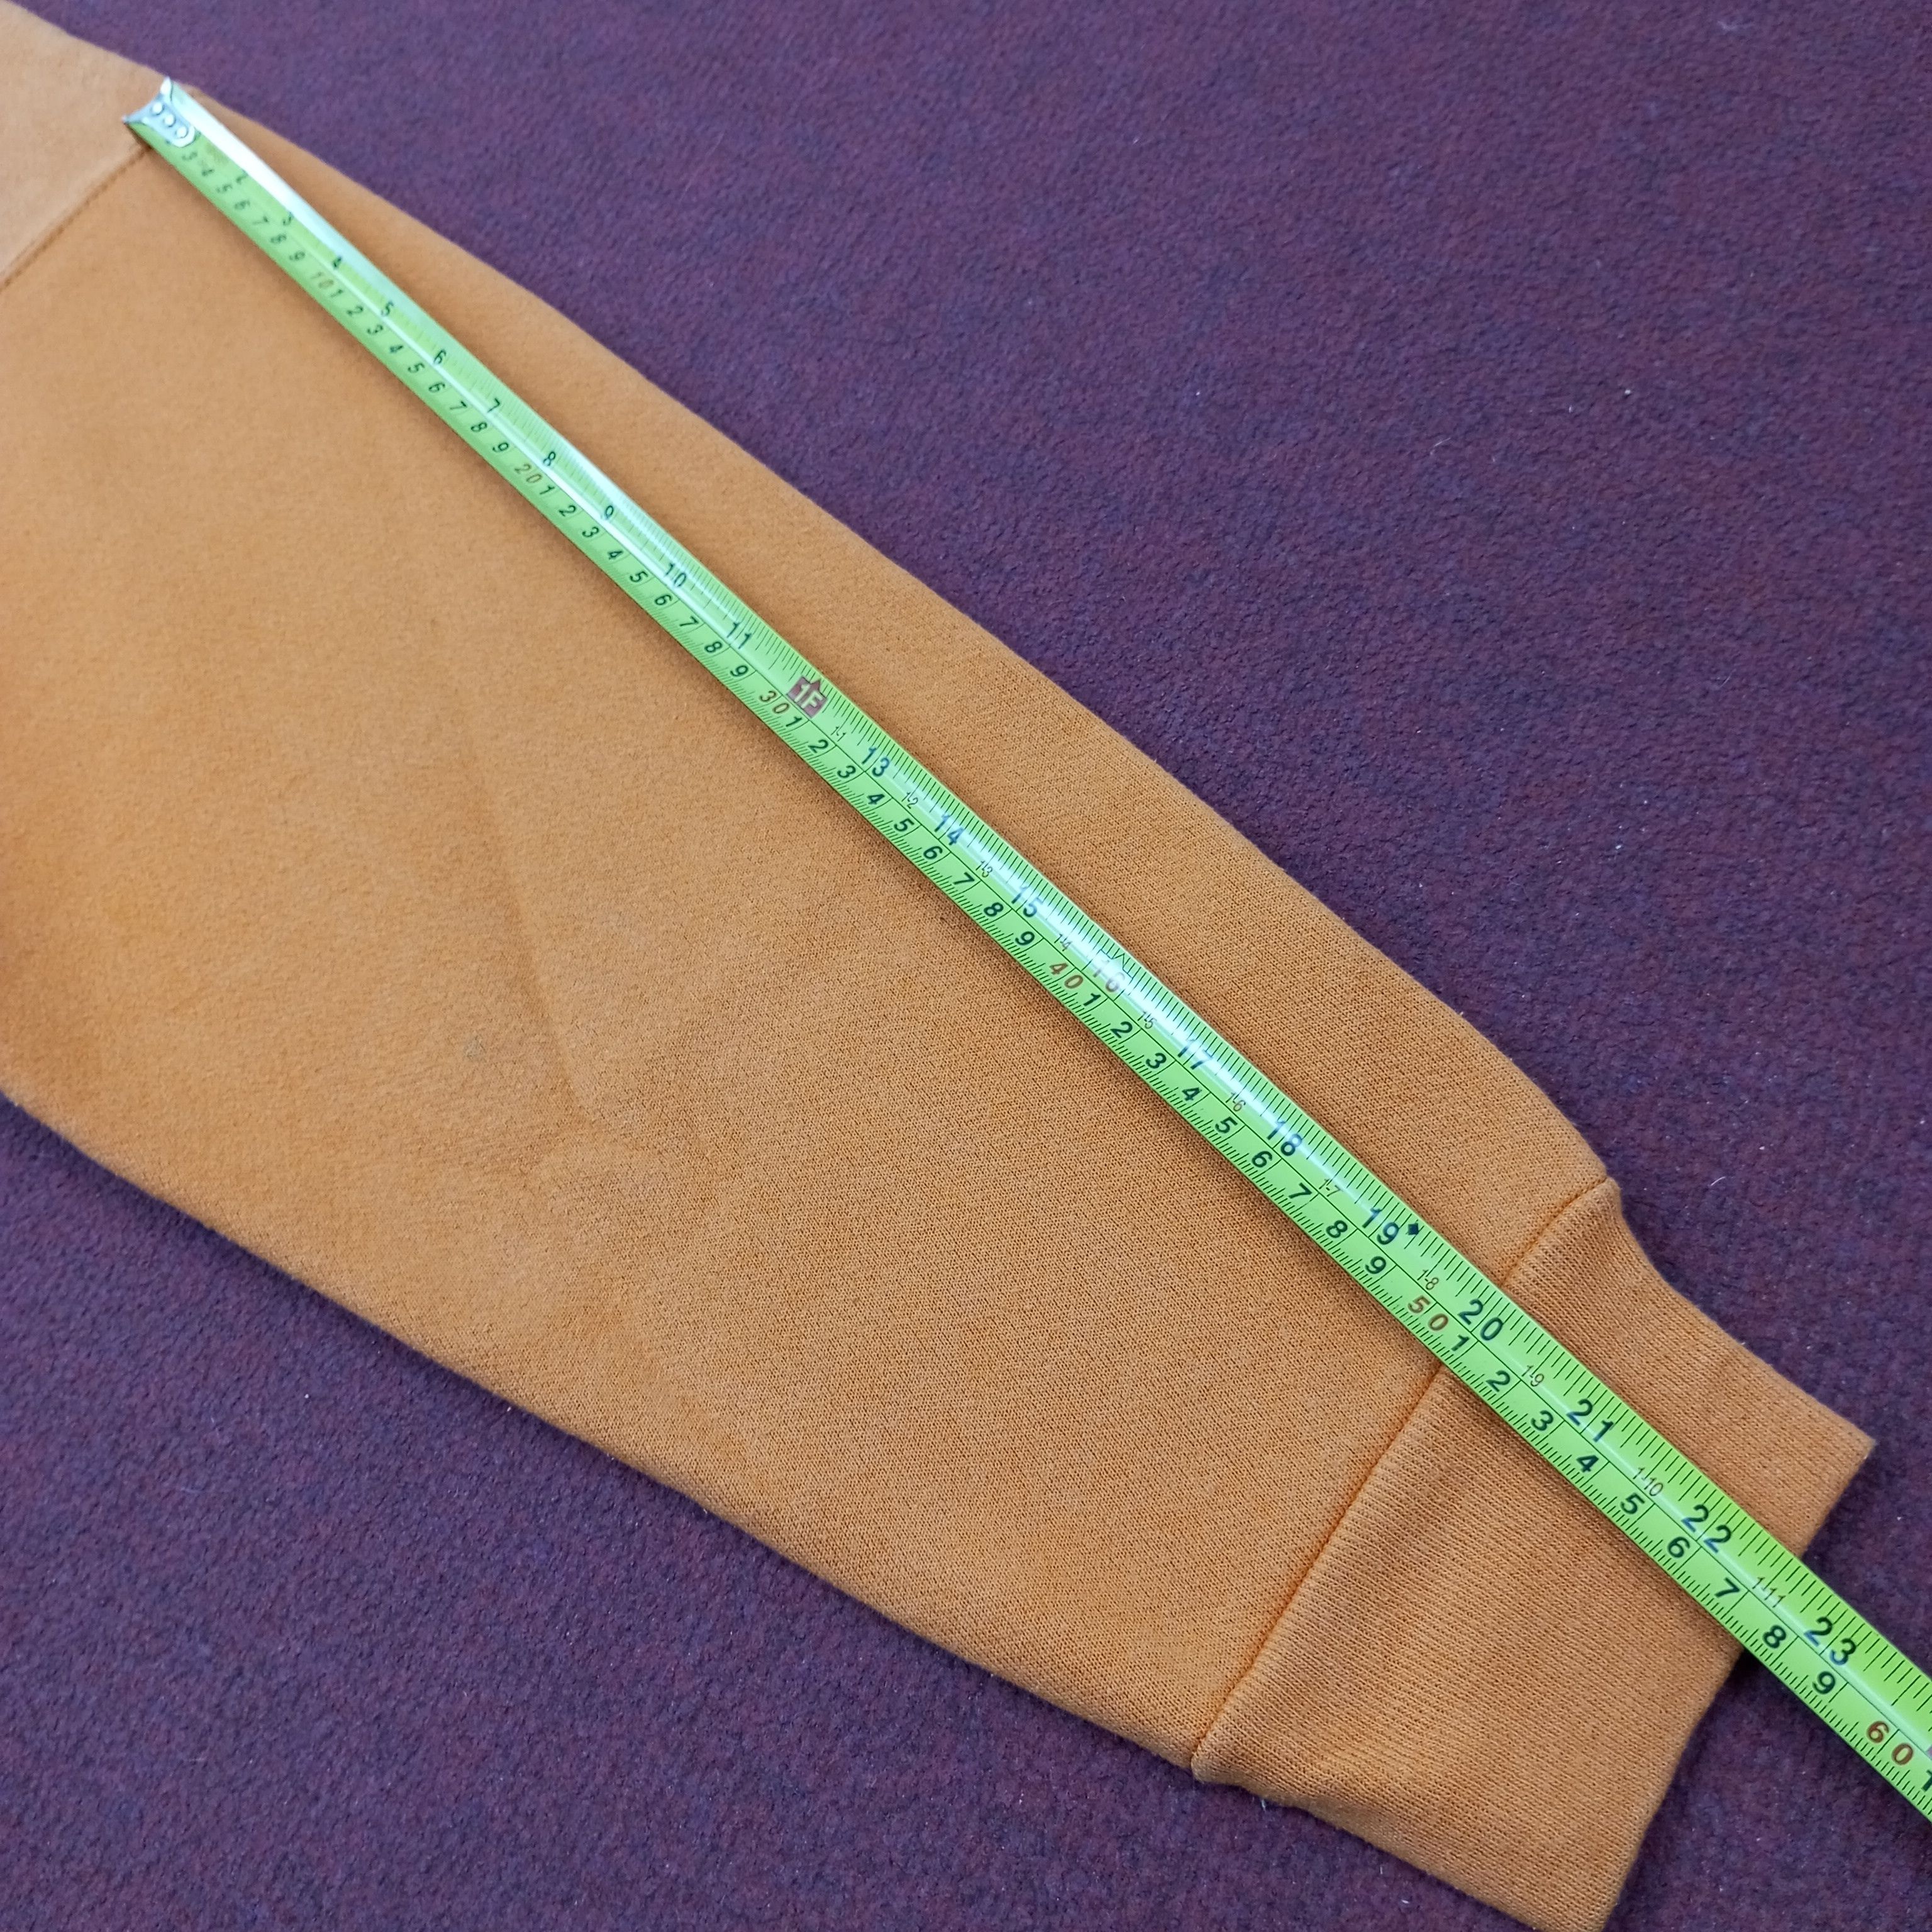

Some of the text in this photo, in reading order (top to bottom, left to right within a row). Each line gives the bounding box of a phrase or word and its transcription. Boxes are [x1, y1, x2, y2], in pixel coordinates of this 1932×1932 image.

[289, 250, 306, 262] 9
[347, 305, 364, 316] 2
[367, 325, 384, 335] 3
[390, 345, 404, 353] 4
[408, 363, 425, 374] 5
[429, 382, 445, 393] 6
[450, 400, 468, 411] 7
[471, 422, 487, 433] 8
[492, 442, 509, 453] 9
[514, 464, 543, 483] 20
[539, 485, 555, 496] 1
[558, 504, 577, 517] 2
[582, 526, 599, 538] 3
[608, 550, 623, 560] 4
[630, 570, 649, 583] 5
[654, 594, 672, 606] 6
[679, 616, 699, 628] 7
[704, 641, 723, 653] 8
[730, 664, 749, 678] 9
[758, 690, 790, 714] 30
[786, 716, 803, 727] 1
[808, 739, 829, 753] 2
[836, 765, 857, 779] 3
[867, 792, 886, 805] 4
[894, 818, 915, 832] 5
[923, 845, 943, 860] 6
[953, 872, 975, 886] 7
[983, 901, 1004, 917] 8
[1015, 931, 1035, 946] 9
[1049, 962, 1084, 989] 40
[1084, 992, 1101, 1007] 1
[1110, 1021, 1133, 1038] 2
[1145, 1052, 1167, 1069] 3
[1182, 1087, 1202, 1101] 4
[1214, 1116, 1238, 1134] 5
[1251, 1150, 1274, 1168] 6
[1289, 1182, 1313, 1199] 7
[1325, 1219, 1348, 1238] 8
[1365, 1256, 1387, 1275] 9
[1407, 1295, 1449, 1331] 50
[1451, 1334, 1470, 1352] 1
[1485, 1370, 1511, 1392] 2
[1531, 1409, 1554, 1432] 3
[1576, 1454, 1599, 1472] 4
[1620, 1492, 1645, 1515] 5
[1667, 1536, 1690, 1558] 6
[1714, 1577, 1741, 1598] 7
[1762, 1624, 1787, 1649] 8
[1812, 1670, 1836, 1695] 9
[1866, 1721, 1914, 1765] 60
[381, 301, 394, 316] 5
[433, 349, 447, 365] 6
[487, 397, 501, 413] 7
[543, 451, 556, 467] 8
[665, 563, 687, 588] 10
[726, 621, 753, 649] 11
[794, 684, 824, 709] 1F
[862, 747, 891, 777] 13
[935, 814, 965, 845] 14
[1011, 883, 1044, 918] 15
[1094, 959, 1126, 992] 16
[1177, 1039, 1213, 1070] 17
[1267, 1119, 1303, 1157] 18
[1362, 1207, 1400, 1245] 19
[1458, 1299, 1504, 1341] 20
[1567, 1398, 1615, 1443] 21
[1681, 1504, 1732, 1553] 22
[1804, 1616, 1857, 1666] 23
